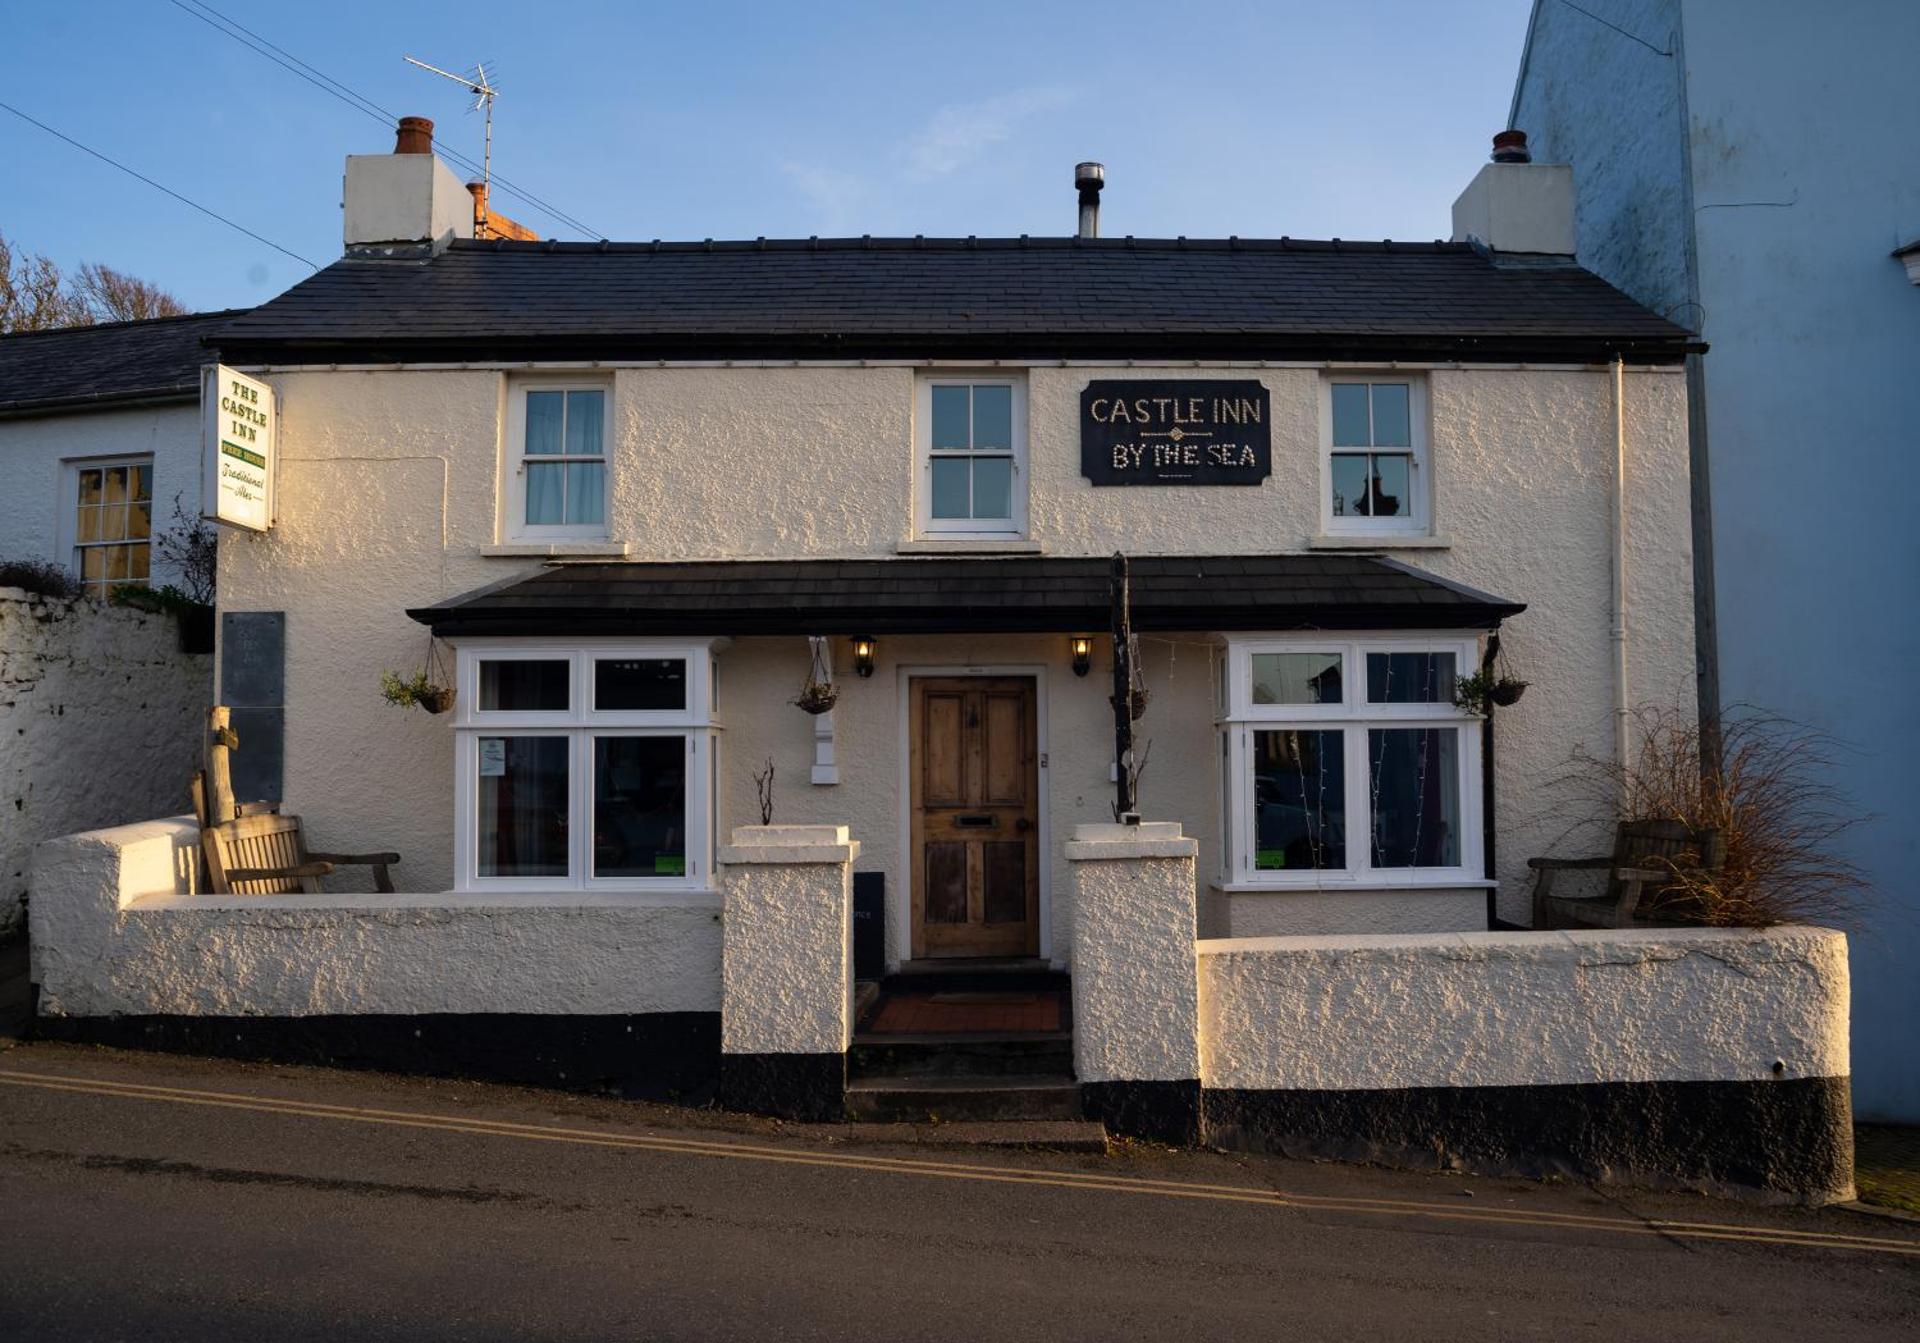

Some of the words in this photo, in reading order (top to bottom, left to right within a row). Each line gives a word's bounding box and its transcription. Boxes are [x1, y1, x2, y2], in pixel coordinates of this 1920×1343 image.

[232, 381, 258, 404] THE
[222, 397, 267, 427] CASTLE
[1091, 398, 1204, 423] CASTLE
[1213, 398, 1261, 423] INN
[232, 420, 257, 442] INN
[1113, 443, 1147, 468] BY
[1151, 443, 1200, 467] THE
[1207, 443, 1256, 467] SEA
[222, 463, 265, 488] Traditional
